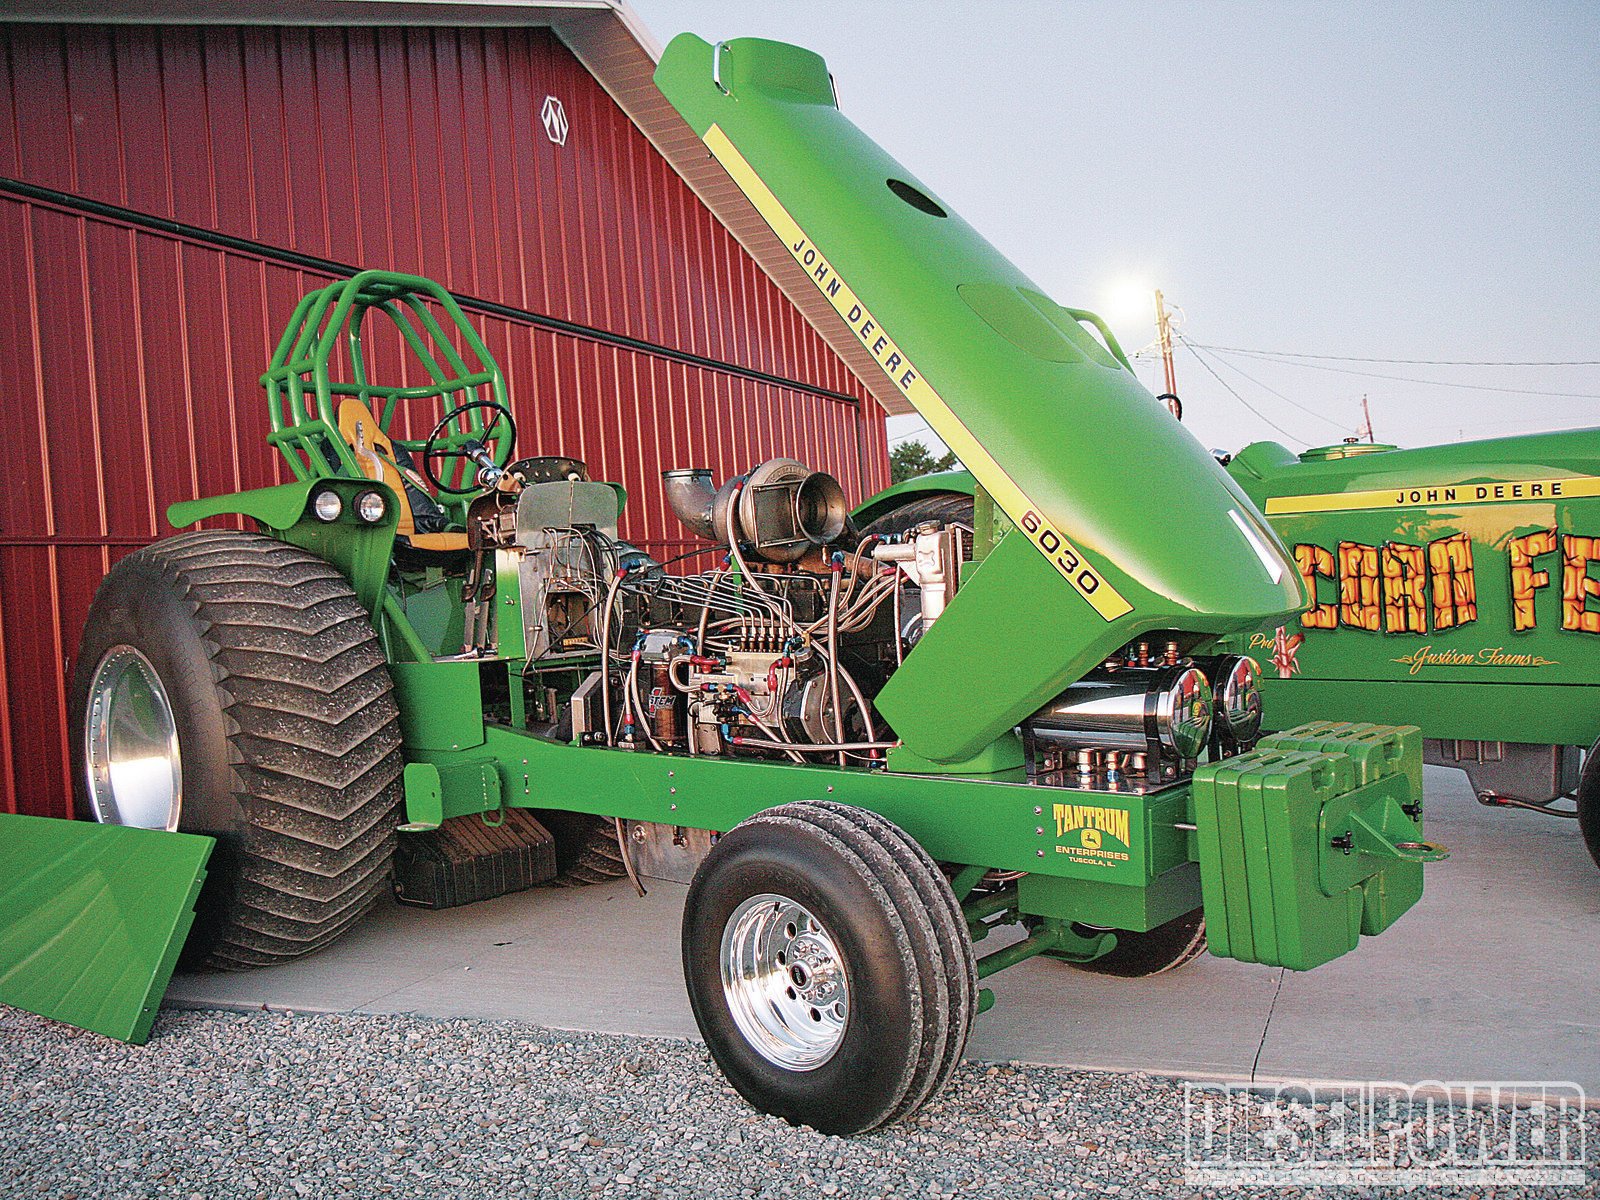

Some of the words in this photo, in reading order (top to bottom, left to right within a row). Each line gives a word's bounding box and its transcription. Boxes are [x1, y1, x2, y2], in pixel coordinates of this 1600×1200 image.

[793, 240, 842, 298] JOHN
[847, 304, 917, 390] DEERE
[1396, 488, 1456, 504] JOHN
[1475, 483, 1562, 500] DEERE
[1020, 510, 1100, 595] 6030
[1294, 531, 1478, 636] CORN
[1409, 645, 1475, 675] Justison
[1475, 647, 1532, 666] Farms
[1052, 803, 1131, 849] TANTRUM
[1055, 845, 1130, 861] ENTERPRISES
